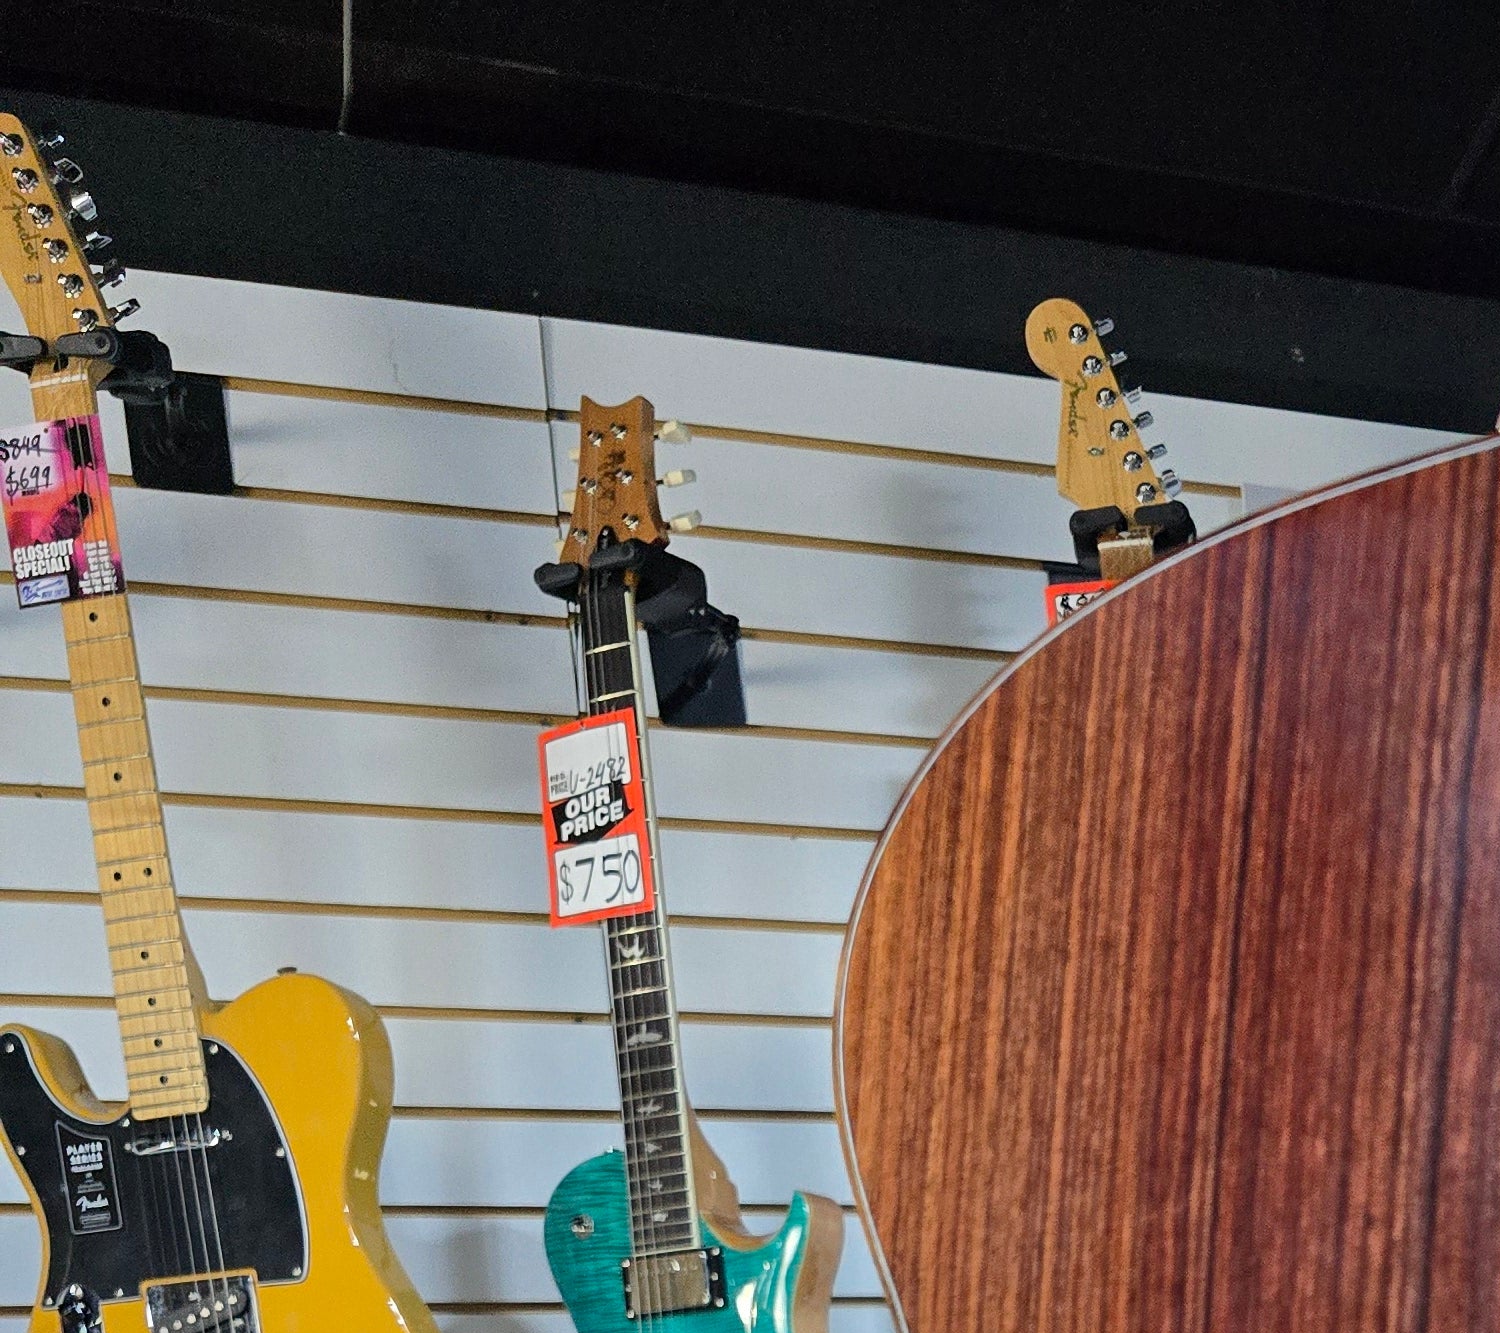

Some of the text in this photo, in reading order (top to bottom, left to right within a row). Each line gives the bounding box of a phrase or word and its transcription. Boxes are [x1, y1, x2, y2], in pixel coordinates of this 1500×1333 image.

[5, 465, 51, 506] $699
[13, 538, 73, 564] CLOSEOUT
[15, 556, 72, 580] SPECIAL!
[560, 799, 624, 843] PRICE
[565, 788, 611, 820] OUR
[560, 849, 641, 905] $750
